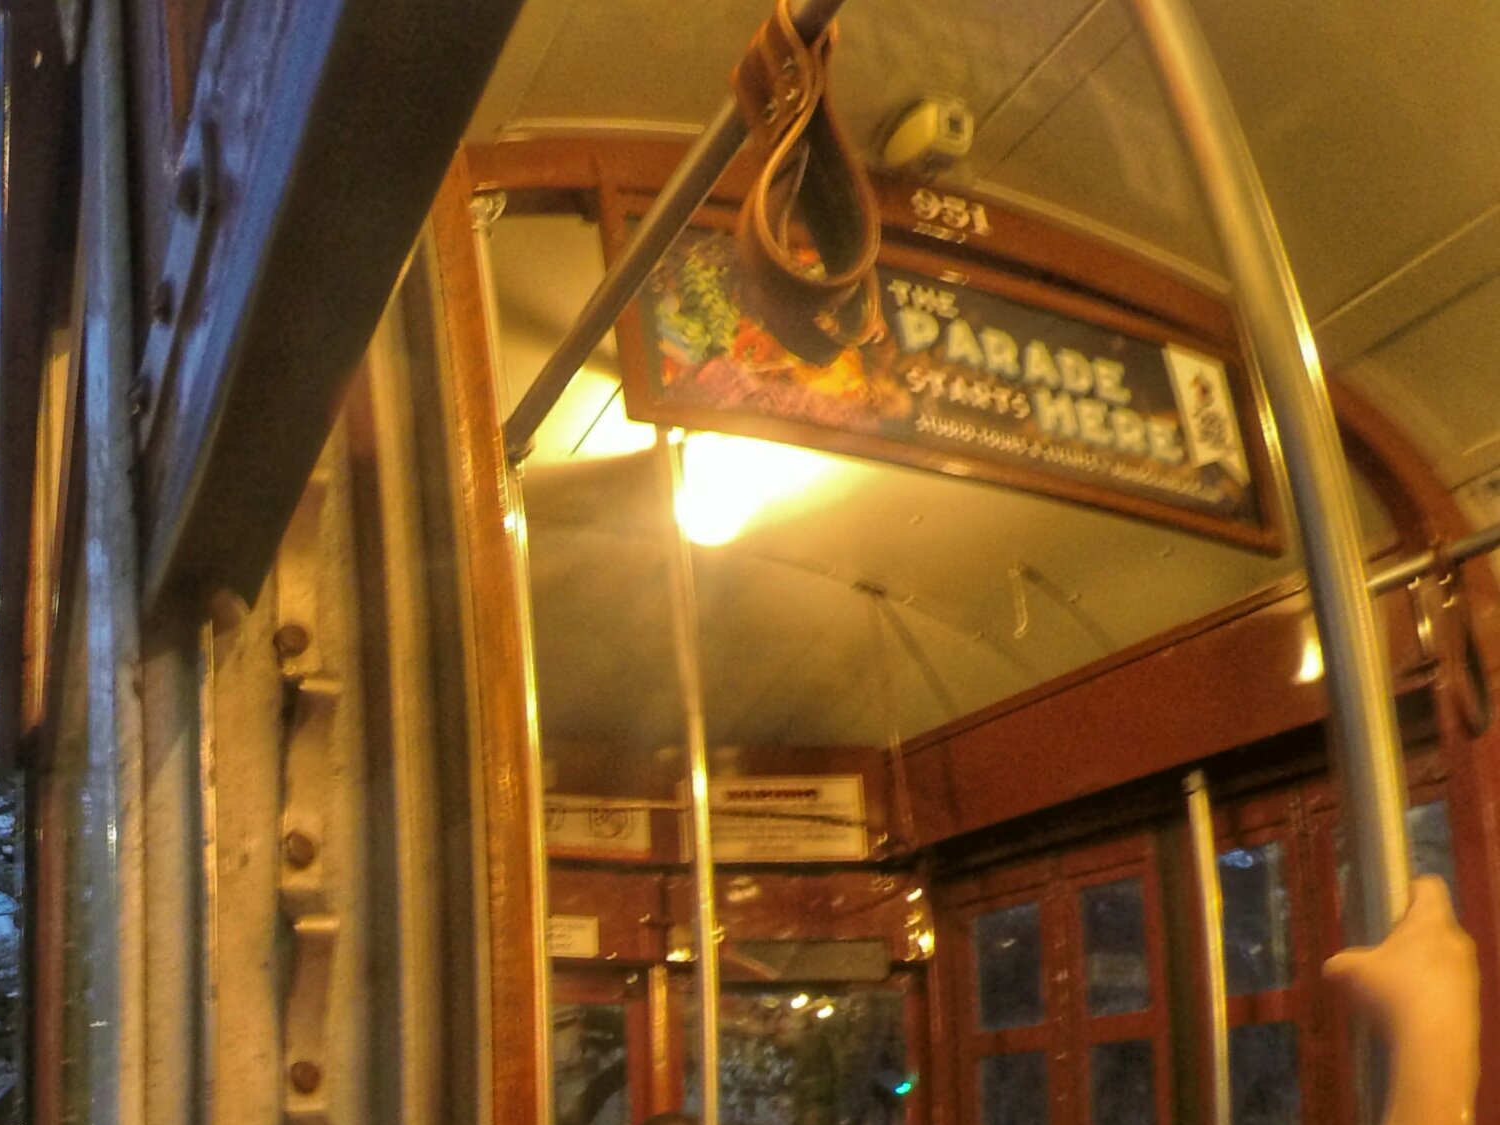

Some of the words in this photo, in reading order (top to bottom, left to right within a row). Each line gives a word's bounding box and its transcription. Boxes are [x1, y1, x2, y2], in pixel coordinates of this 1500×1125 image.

[888, 279, 959, 319] THE
[898, 306, 1132, 407] PARADE
[906, 365, 1031, 420] STARTS
[1035, 387, 1184, 467] HERE
